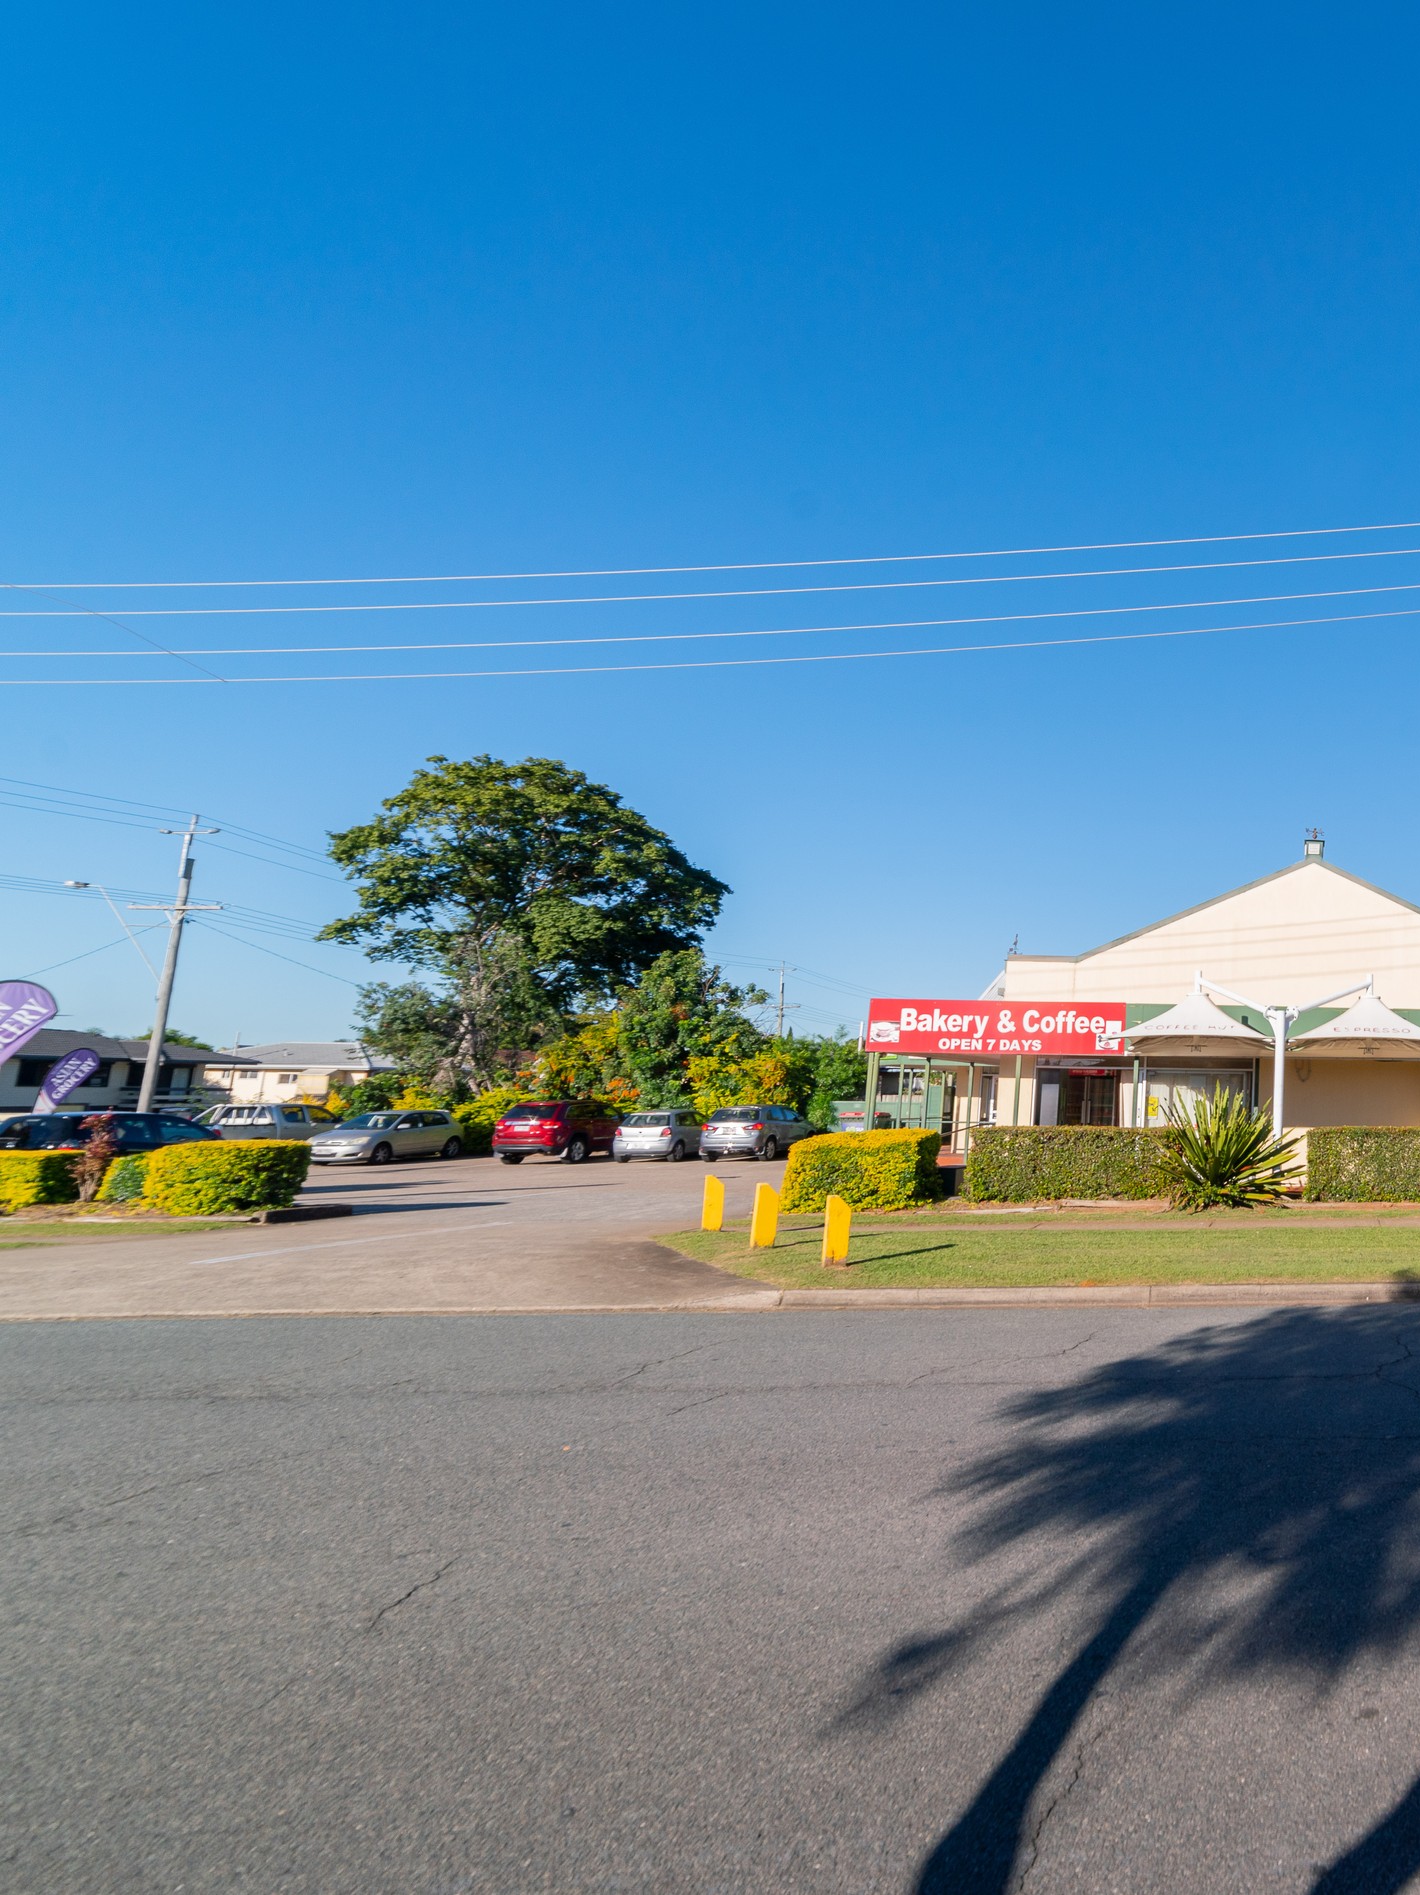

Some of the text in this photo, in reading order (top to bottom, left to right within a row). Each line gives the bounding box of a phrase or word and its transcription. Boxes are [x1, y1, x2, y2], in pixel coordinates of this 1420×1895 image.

[900, 1008, 1106, 1038] Bakery & Coffee
[938, 1037, 1042, 1052] OPEN 7 DAYS
[51, 1057, 82, 1087] ASIAN
[52, 1057, 97, 1099] GROCERY
